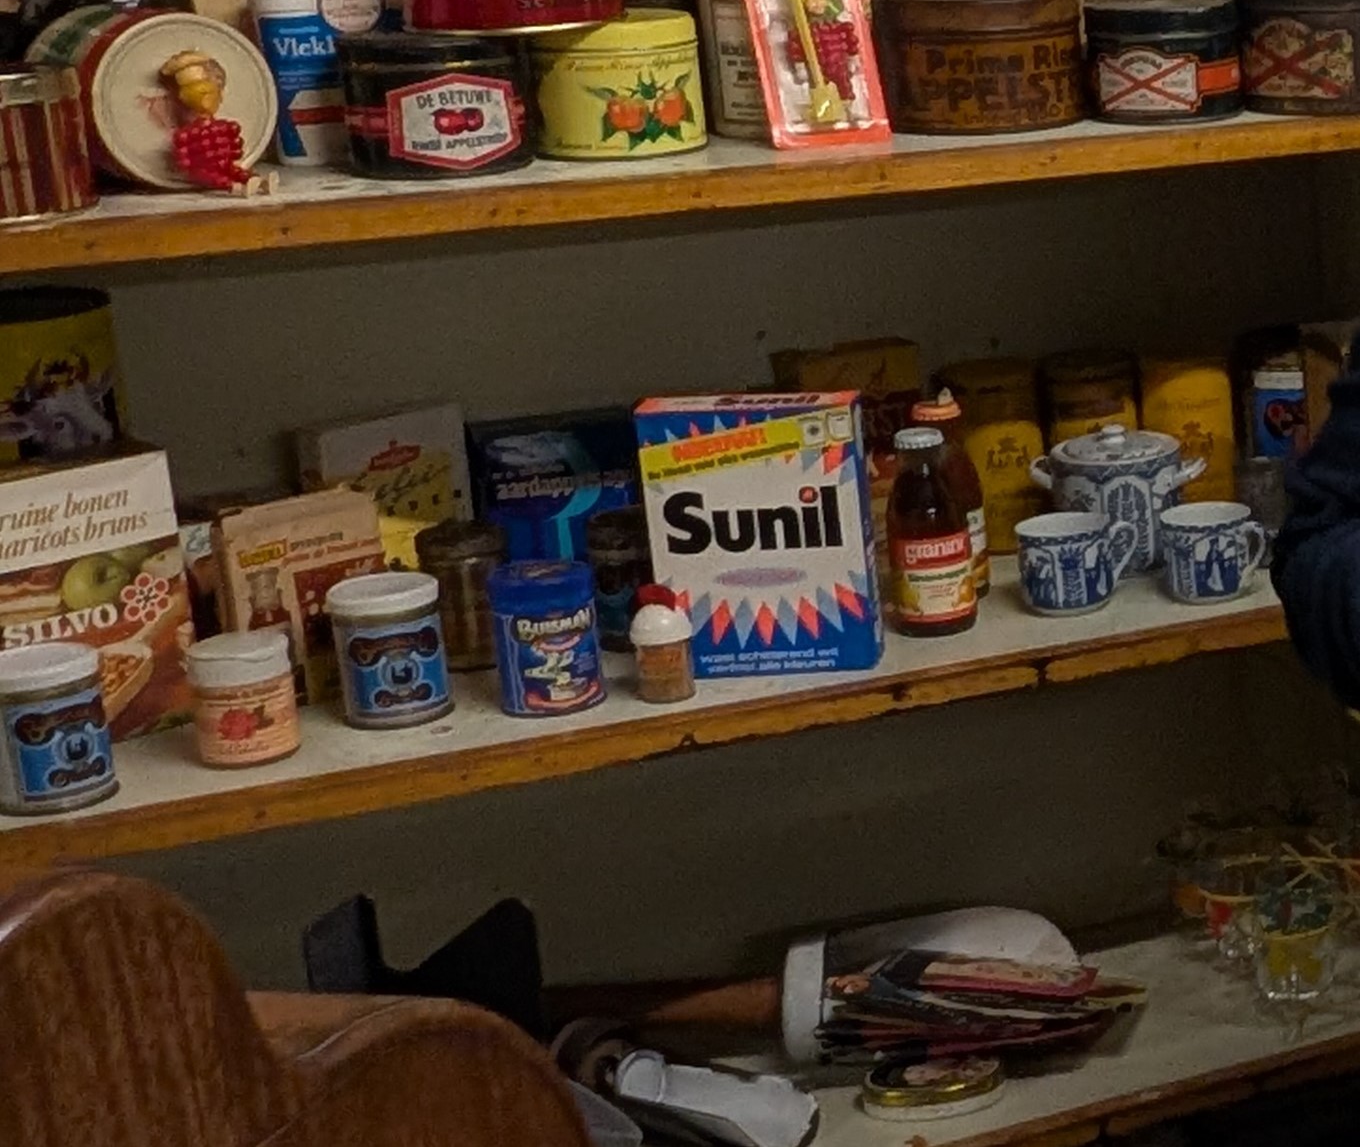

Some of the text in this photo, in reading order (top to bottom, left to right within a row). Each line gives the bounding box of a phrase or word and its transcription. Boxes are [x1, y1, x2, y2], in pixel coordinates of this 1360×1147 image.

[925, 48, 1026, 75] Prima
[416, 89, 493, 110] DE BETUWE
[0, 489, 129, 532] ruine bonen
[83, 511, 149, 543] bruns
[663, 485, 844, 556] Sunil
[905, 536, 968, 563] granini
[3, 602, 119, 650] SILVO
[516, 607, 592, 642] BUISMAN
